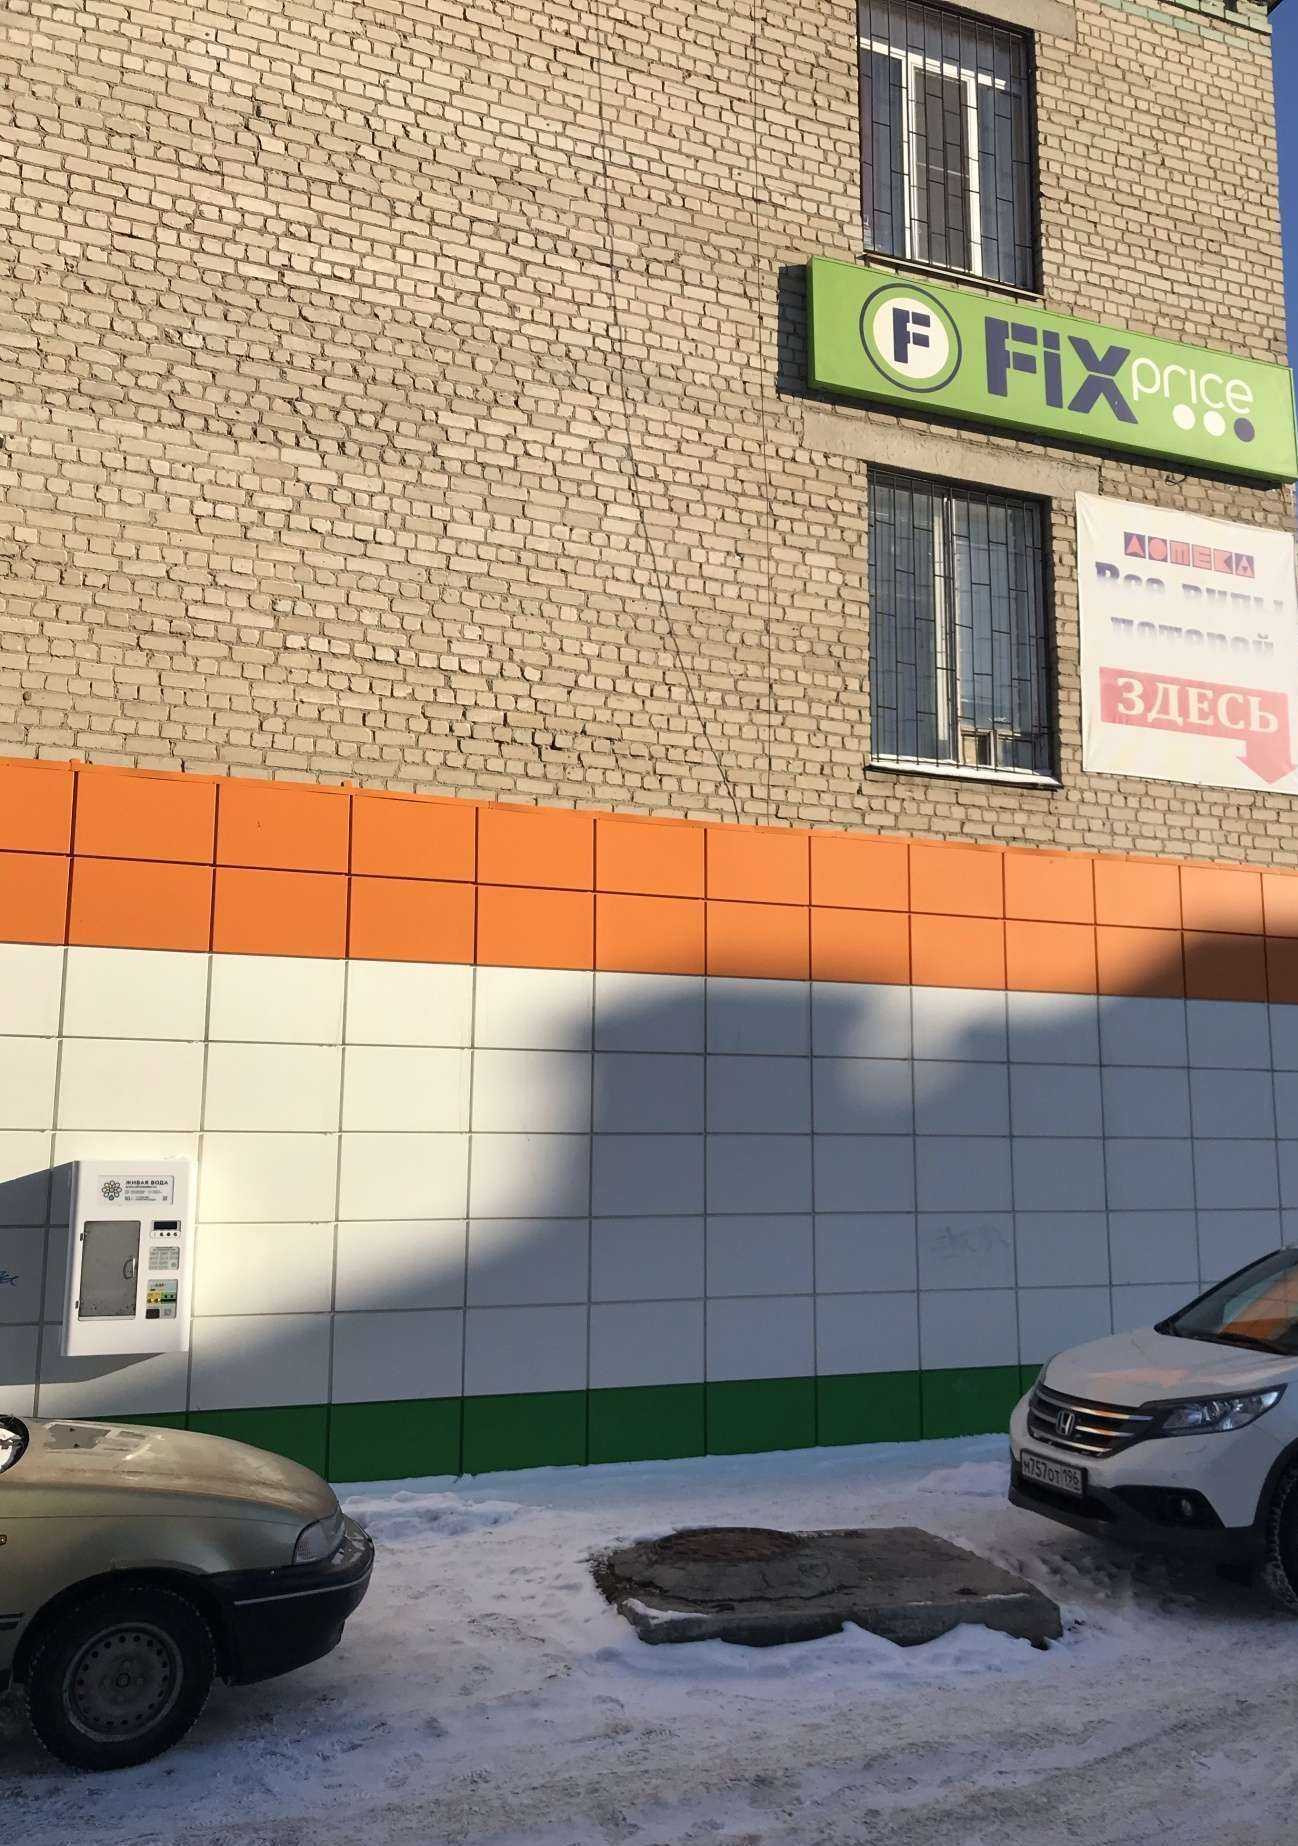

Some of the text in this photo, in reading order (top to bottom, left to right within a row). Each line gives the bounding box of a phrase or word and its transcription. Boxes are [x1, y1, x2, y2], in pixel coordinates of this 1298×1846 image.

[892, 307, 931, 364] F
[1131, 356, 1254, 414] price
[1116, 677, 1280, 734] ЗДЕСЬ
